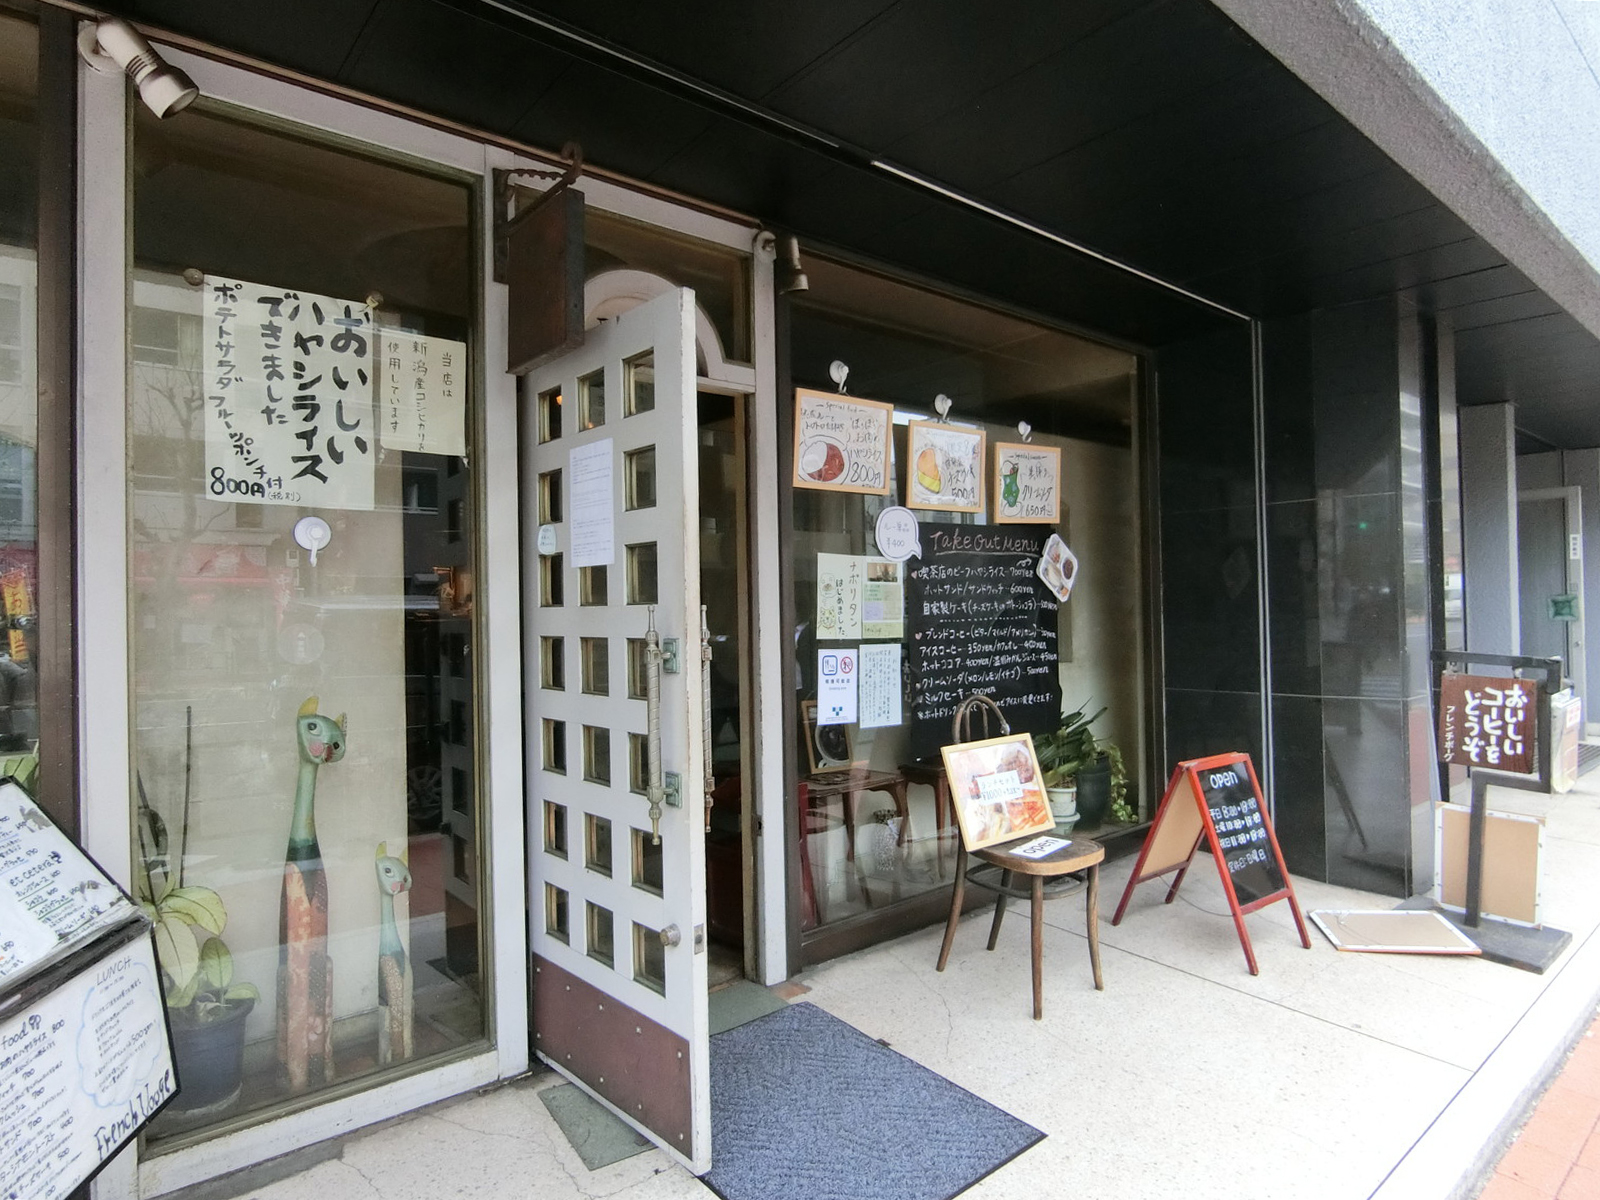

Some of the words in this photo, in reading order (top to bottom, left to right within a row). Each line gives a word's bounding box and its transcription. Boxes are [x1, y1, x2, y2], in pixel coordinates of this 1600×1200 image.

[213, 282, 243, 391] ポテトサラダ
[257, 292, 300, 426] できました
[288, 301, 329, 484] ハヤシライス
[326, 304, 369, 465] おいしい
[388, 341, 402, 435] 使用しています
[441, 350, 453, 399] 当店は
[210, 466, 266, 499] 800円
[848, 560, 860, 629] ナポリタン
[1462, 689, 1486, 763] どうぞ
[1481, 686, 1504, 765] コーヒーを
[1503, 683, 1529, 756] おいしい
[95, 954, 133, 987] LUNCH
[93, 1099, 140, 1162] French
